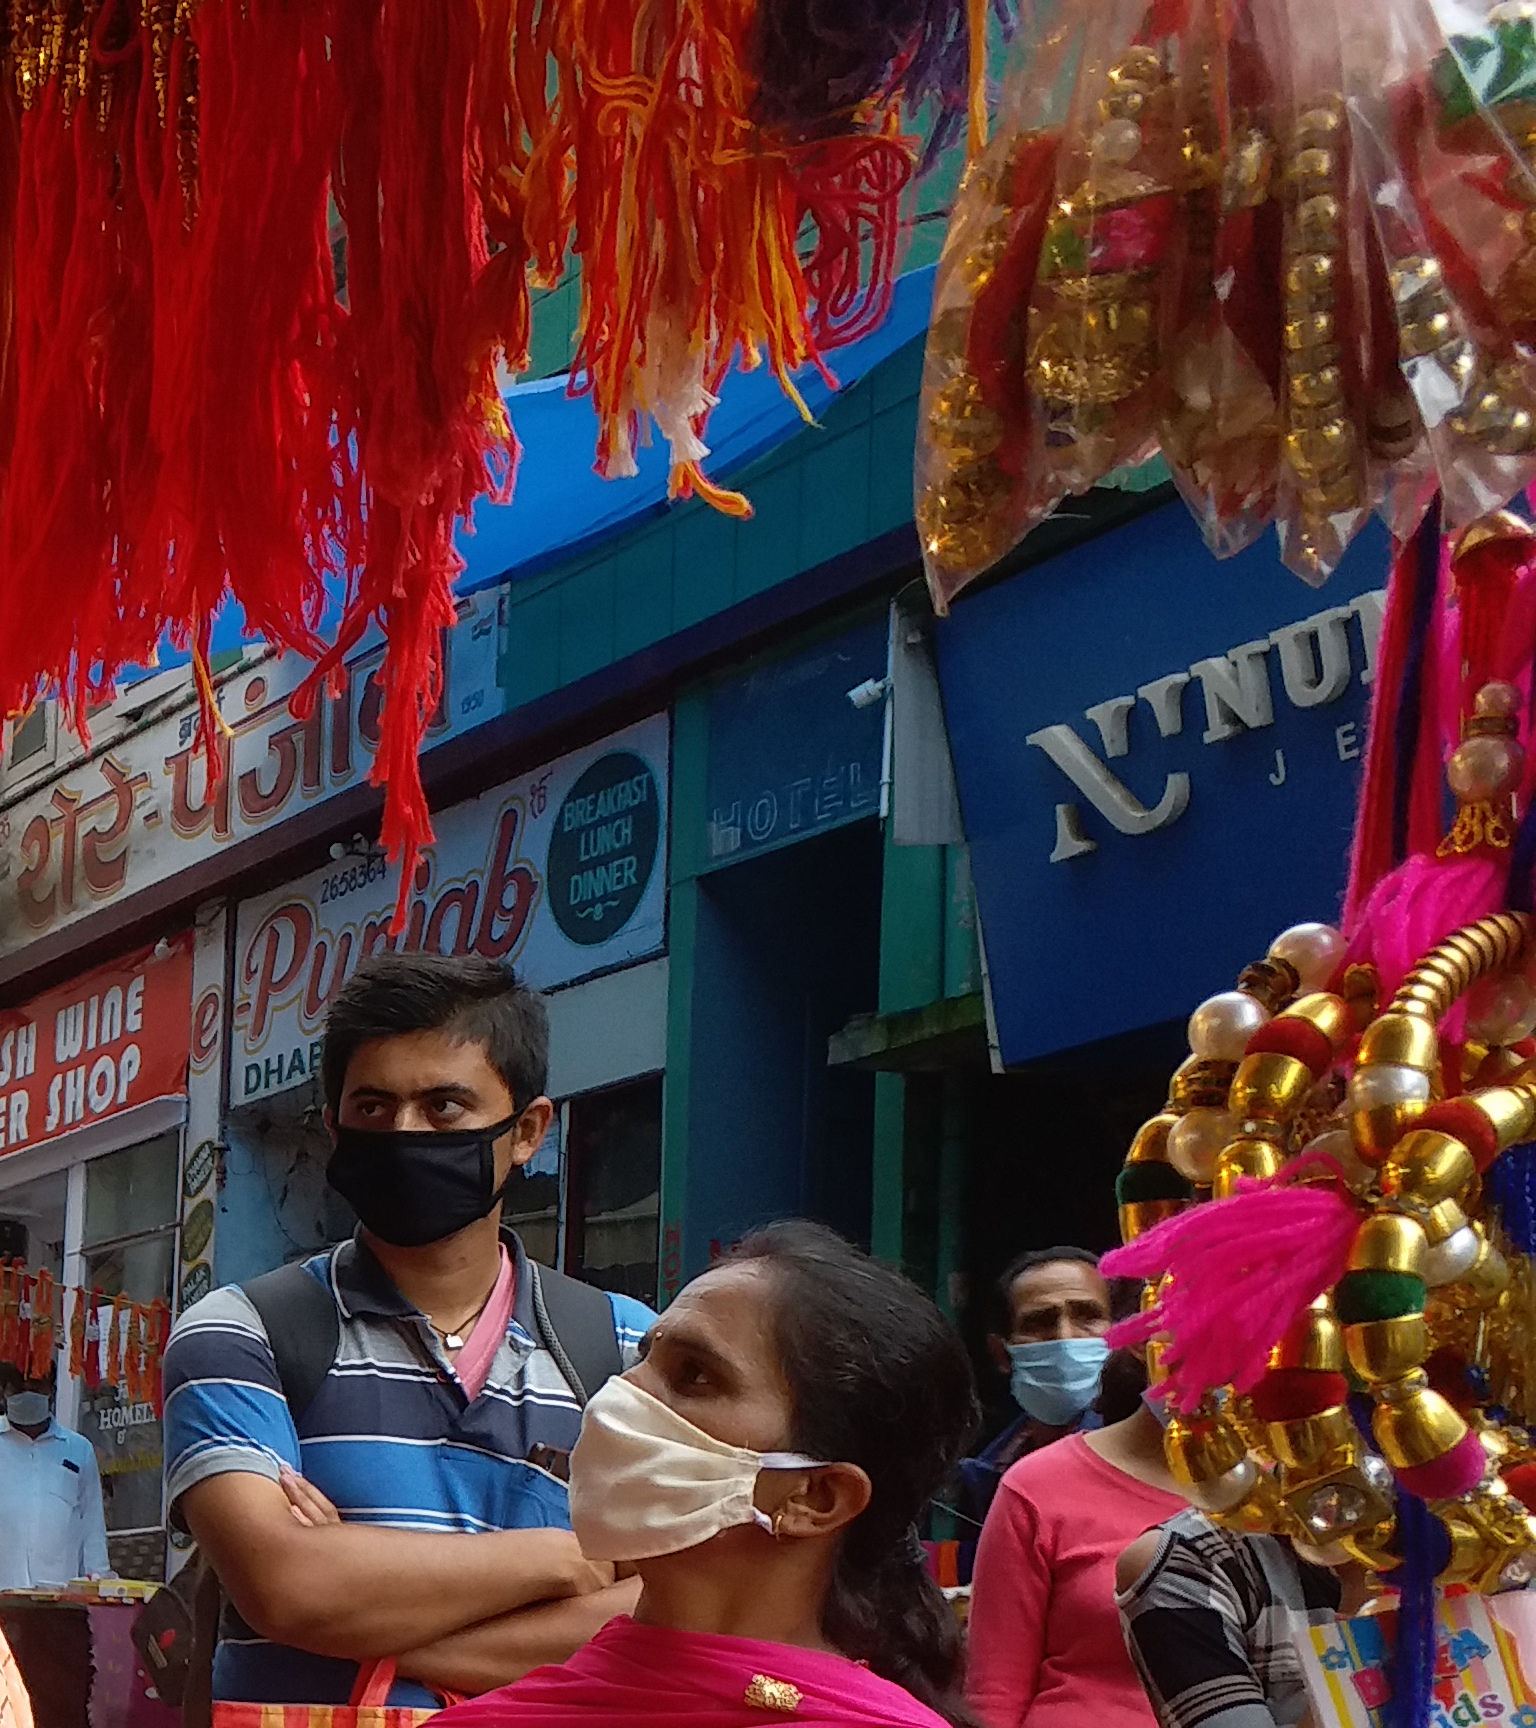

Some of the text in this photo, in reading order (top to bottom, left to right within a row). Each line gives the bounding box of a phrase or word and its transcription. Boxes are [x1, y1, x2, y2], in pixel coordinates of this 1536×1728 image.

[562, 771, 652, 833] BREAKFAST
[579, 815, 633, 862] LUNCH
[712, 763, 879, 857] HOTEL
[569, 857, 638, 906] DINNER
[55, 975, 146, 1064] WINE
[45, 1043, 141, 1132] SHOP
